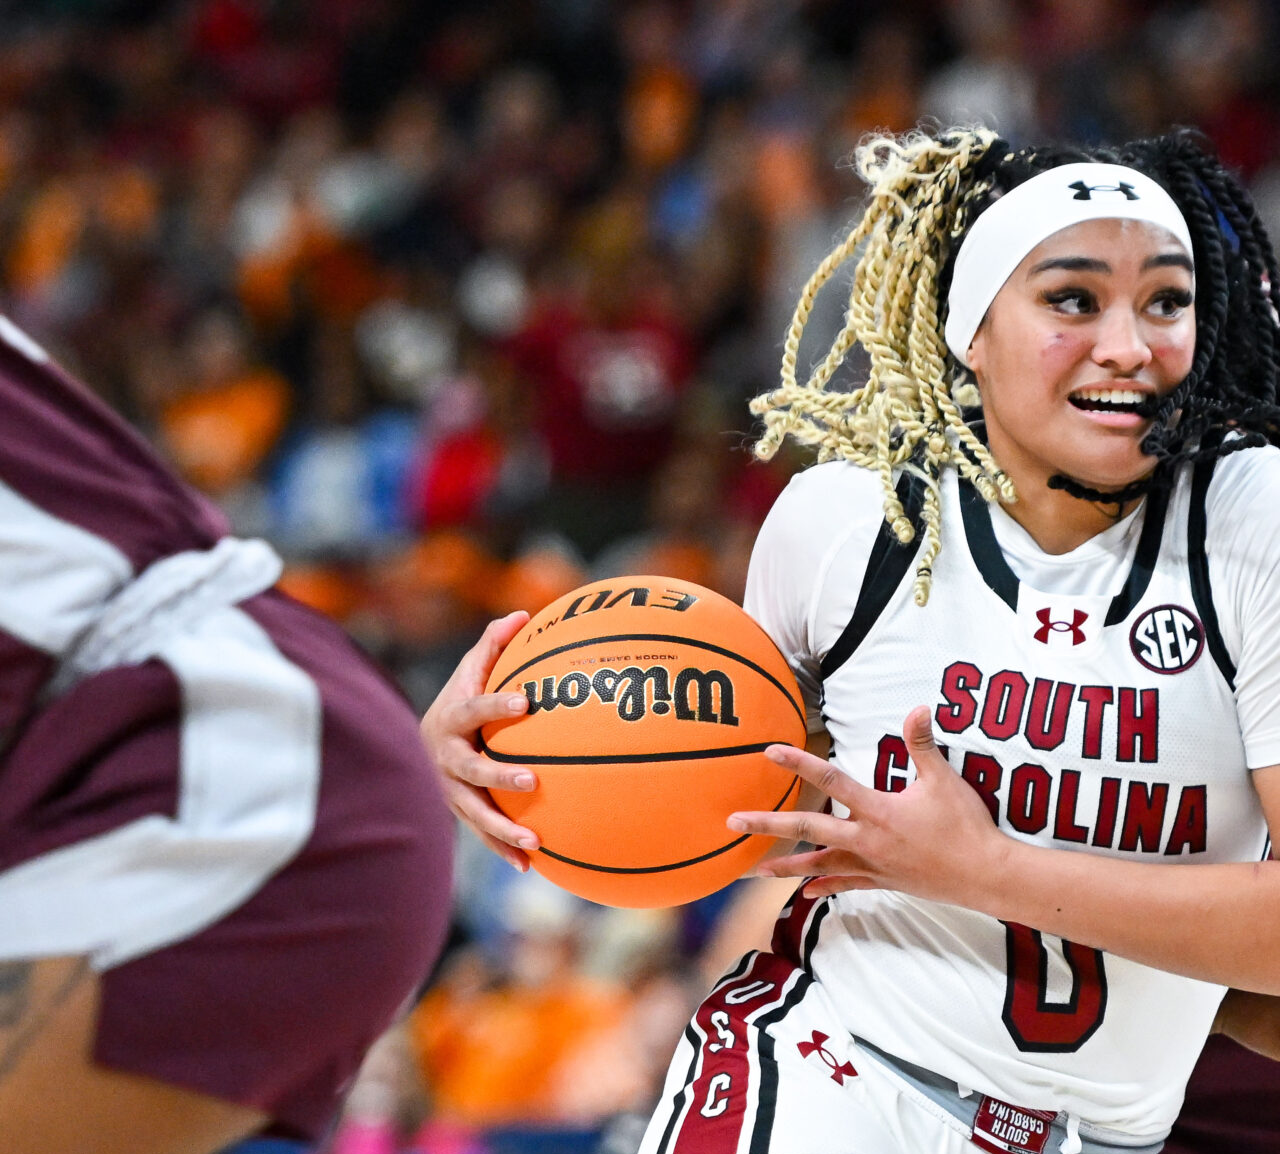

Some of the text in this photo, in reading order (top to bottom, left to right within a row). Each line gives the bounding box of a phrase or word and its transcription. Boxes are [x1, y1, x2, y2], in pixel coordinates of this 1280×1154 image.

[561, 587, 699, 622] EVO
[1135, 609, 1198, 670] SEC
[523, 664, 740, 728] Wilson
[935, 660, 1159, 764] SOUTH
[873, 732, 1208, 856] CROLINA
[988, 1099, 1044, 1135] CAROLINA
[991, 1118, 1031, 1146] SOUTH
